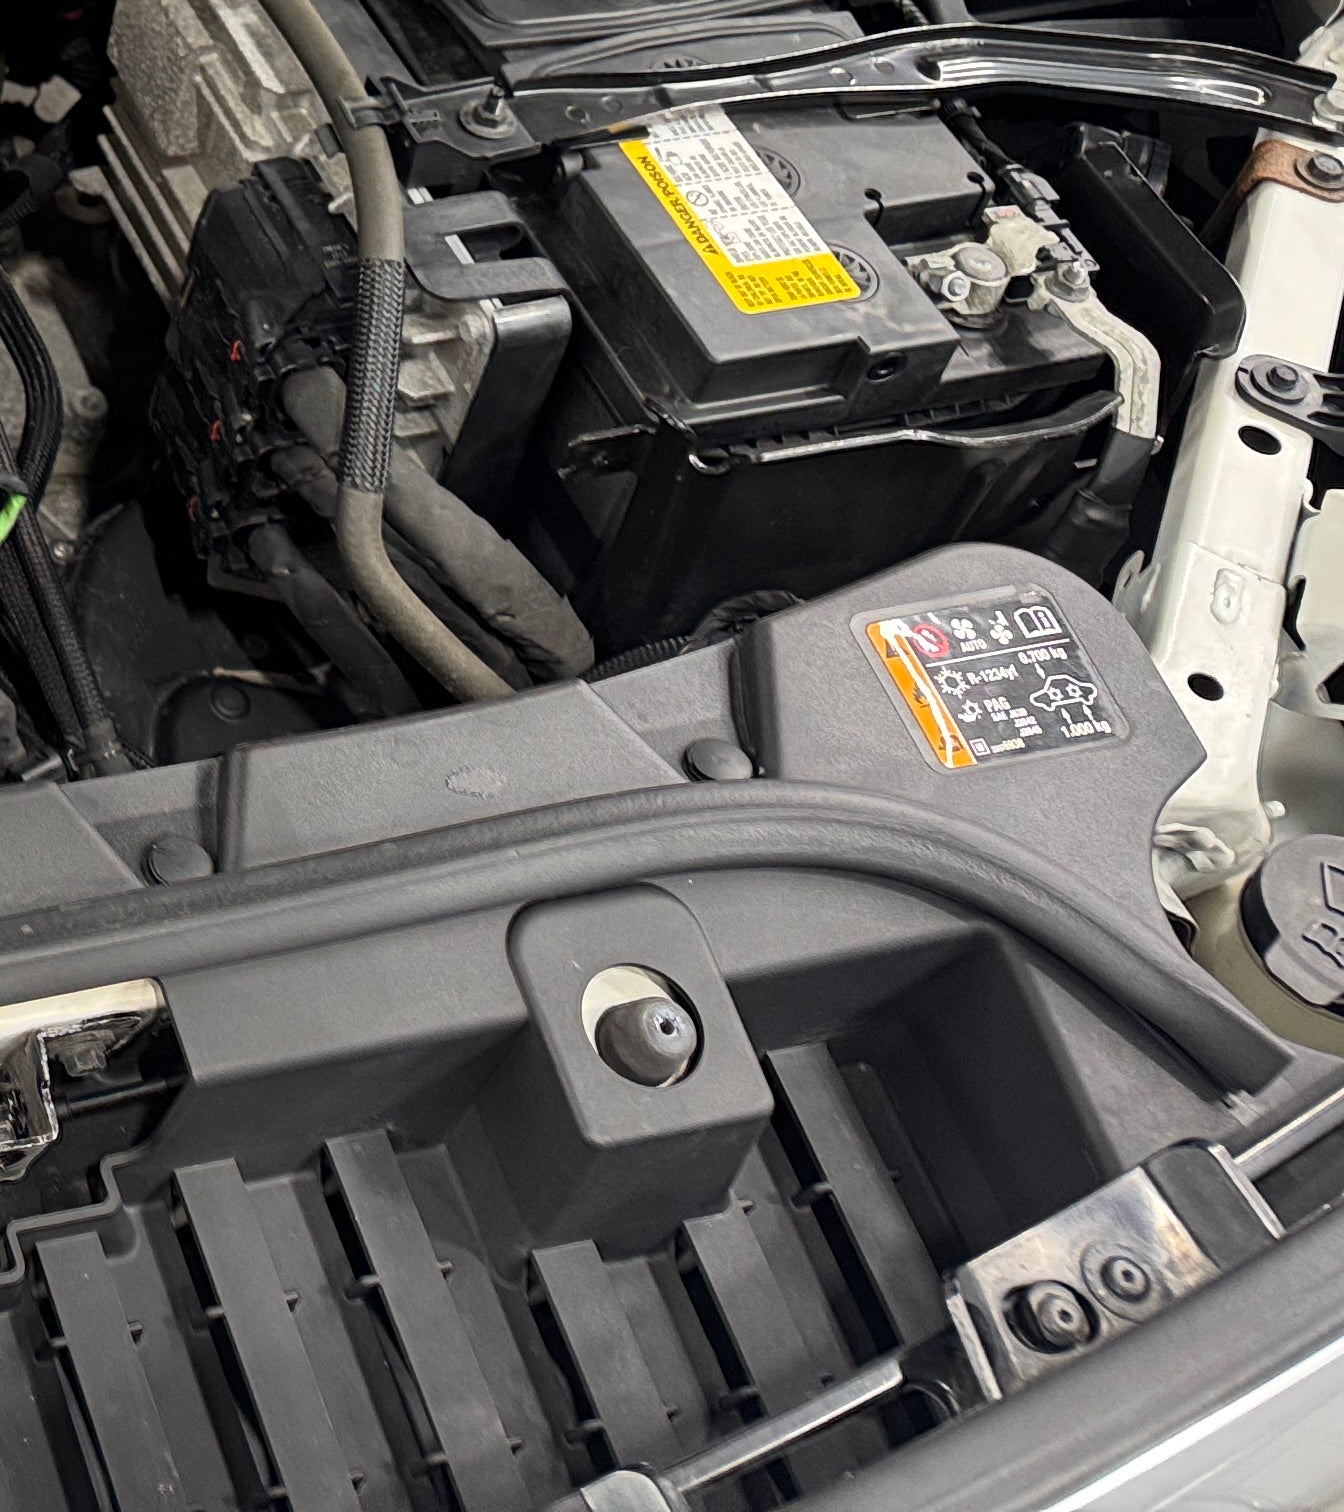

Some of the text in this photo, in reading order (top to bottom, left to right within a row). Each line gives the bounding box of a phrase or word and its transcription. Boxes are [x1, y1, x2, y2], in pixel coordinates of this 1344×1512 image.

[637, 155, 710, 244] DANGER POISON
[960, 638, 988, 653] AUTO
[1050, 647, 1068, 661] kg
[983, 696, 1012, 713] PAG
[1060, 720, 1112, 739] 1.000 kg
